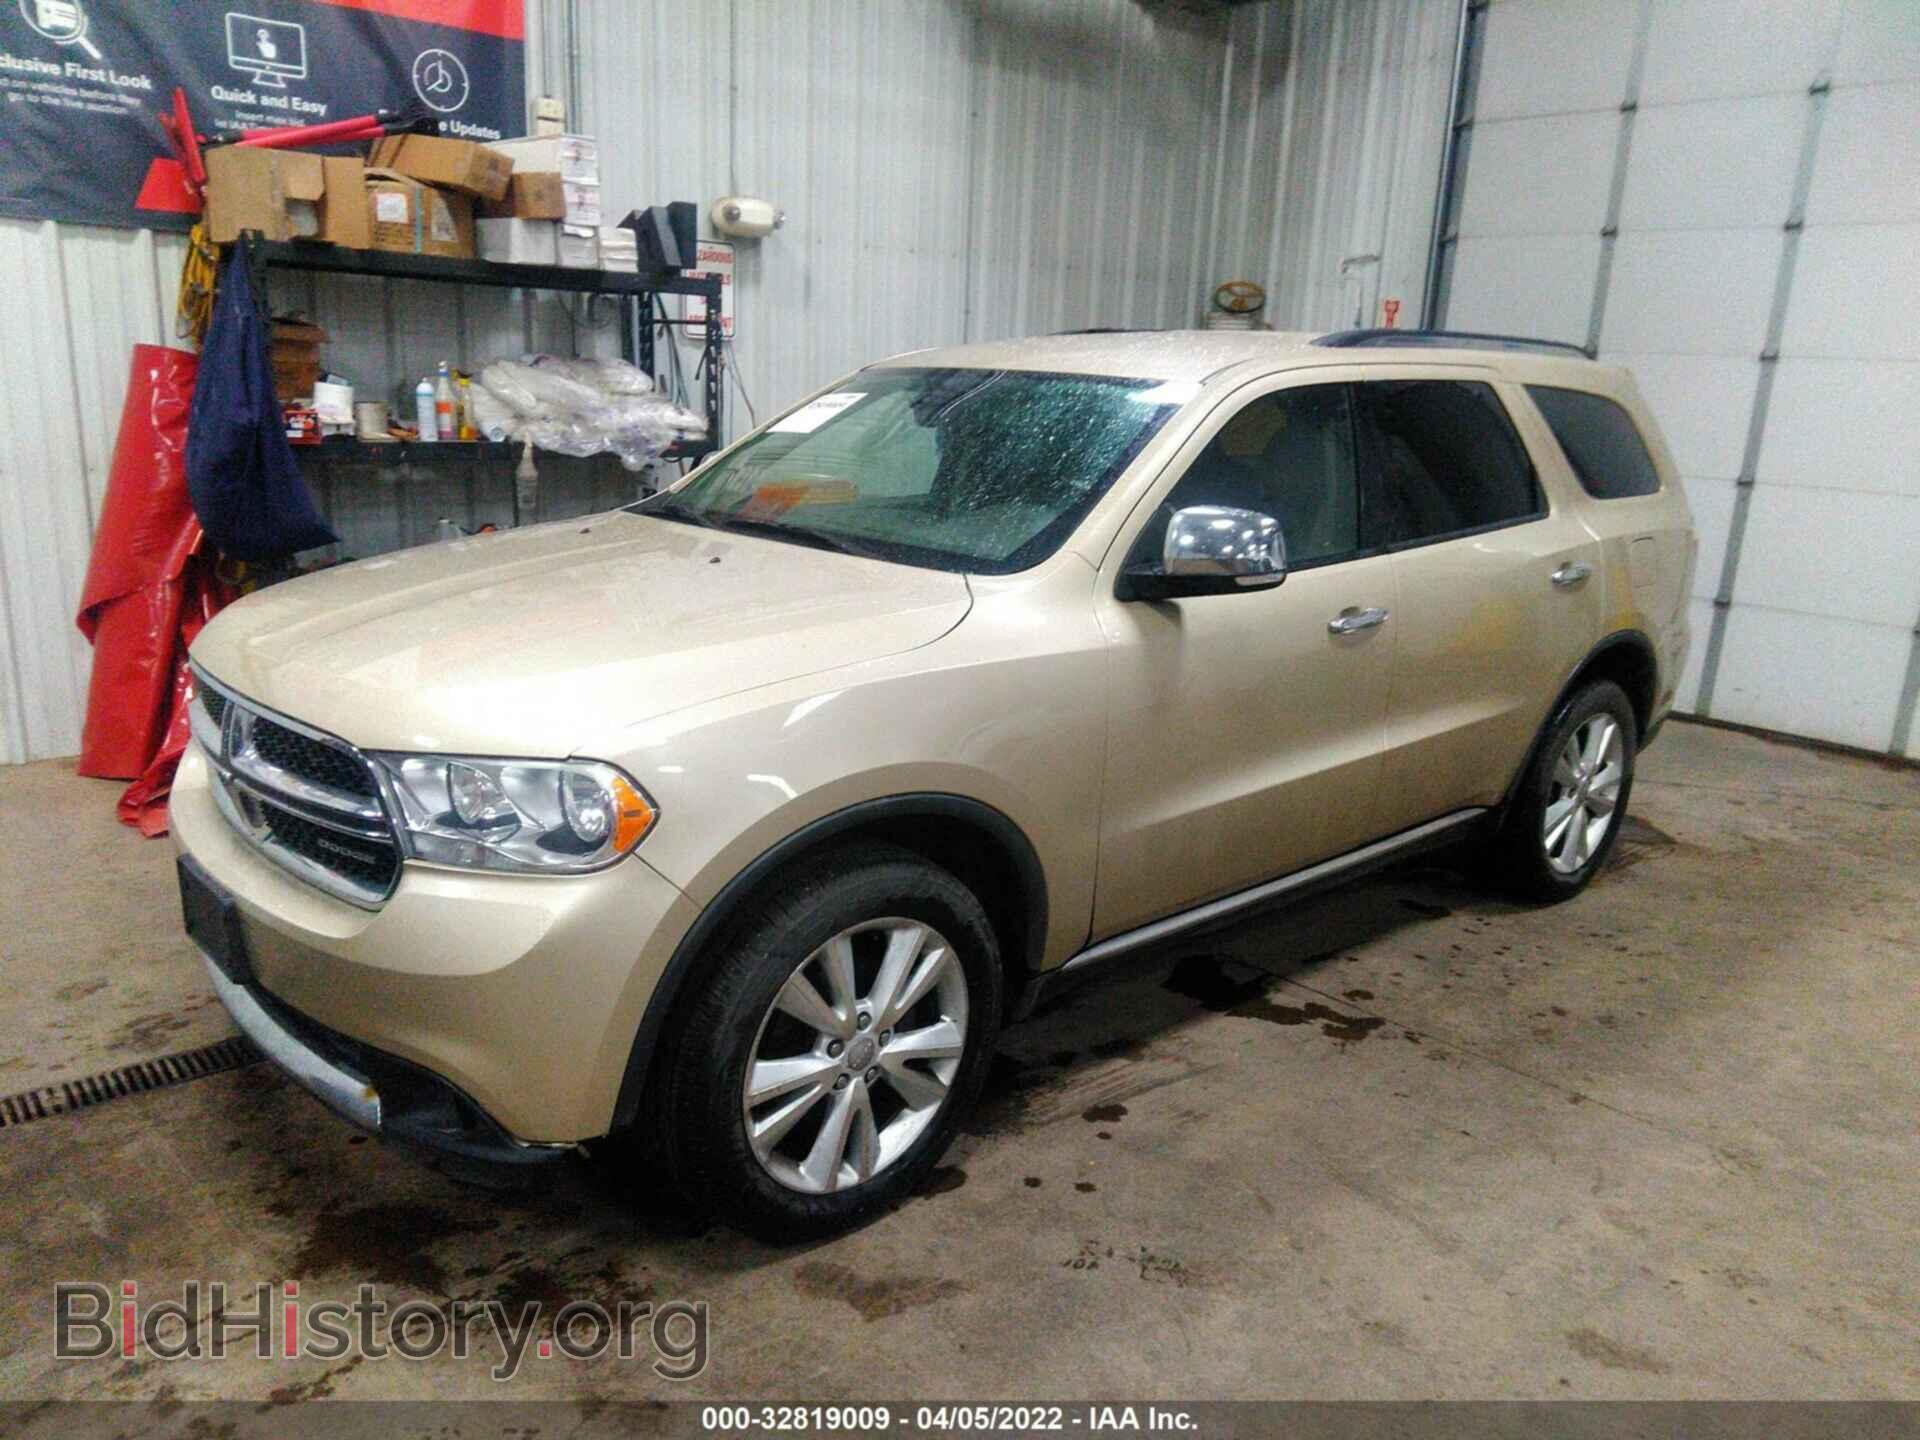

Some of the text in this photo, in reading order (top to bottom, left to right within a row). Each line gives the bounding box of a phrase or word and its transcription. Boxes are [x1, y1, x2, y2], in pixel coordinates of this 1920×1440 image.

[64, 61, 106, 82] First
[108, 69, 152, 90] Look
[211, 85, 328, 117] Quick and Easy
[449, 119, 501, 140] Updates
